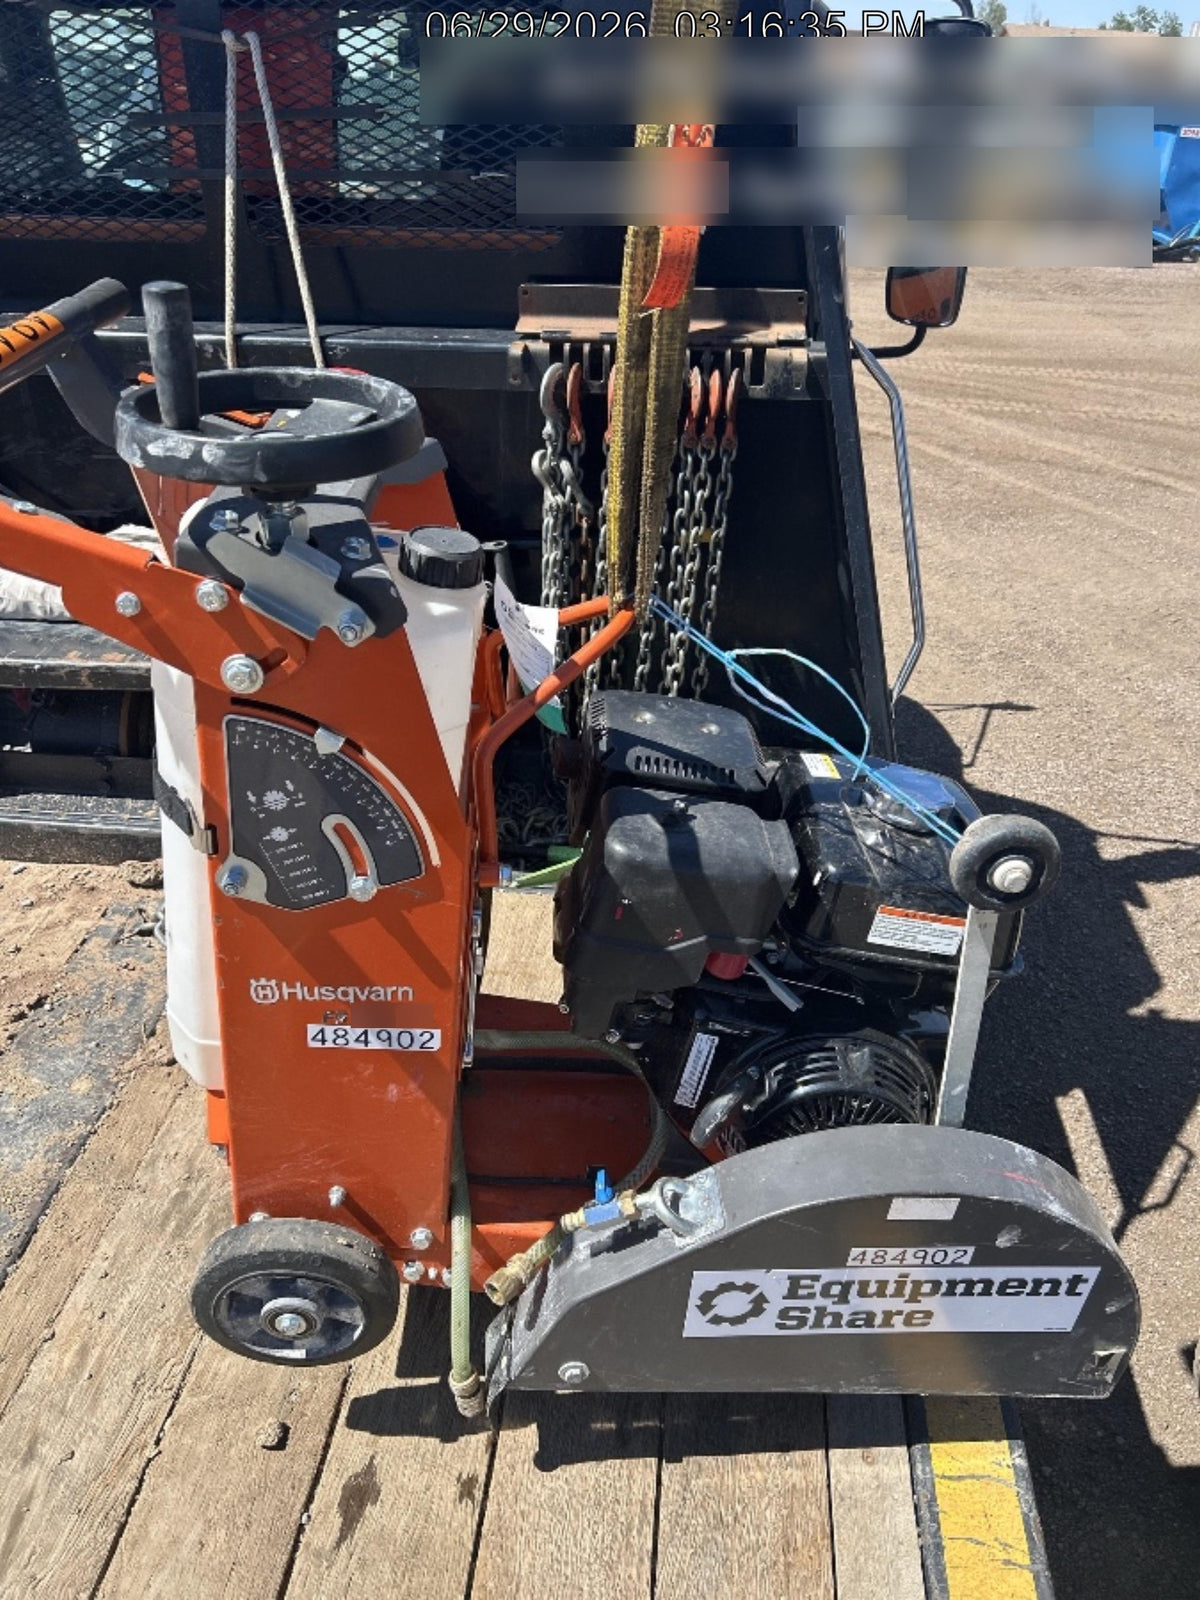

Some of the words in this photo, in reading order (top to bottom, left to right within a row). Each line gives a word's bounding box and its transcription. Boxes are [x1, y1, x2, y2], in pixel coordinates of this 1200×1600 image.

[311, 1027, 435, 1050] 484902
[851, 1249, 968, 1265] 484902
[782, 1273, 1089, 1305] Equipment
[775, 1305, 934, 1331] Share
